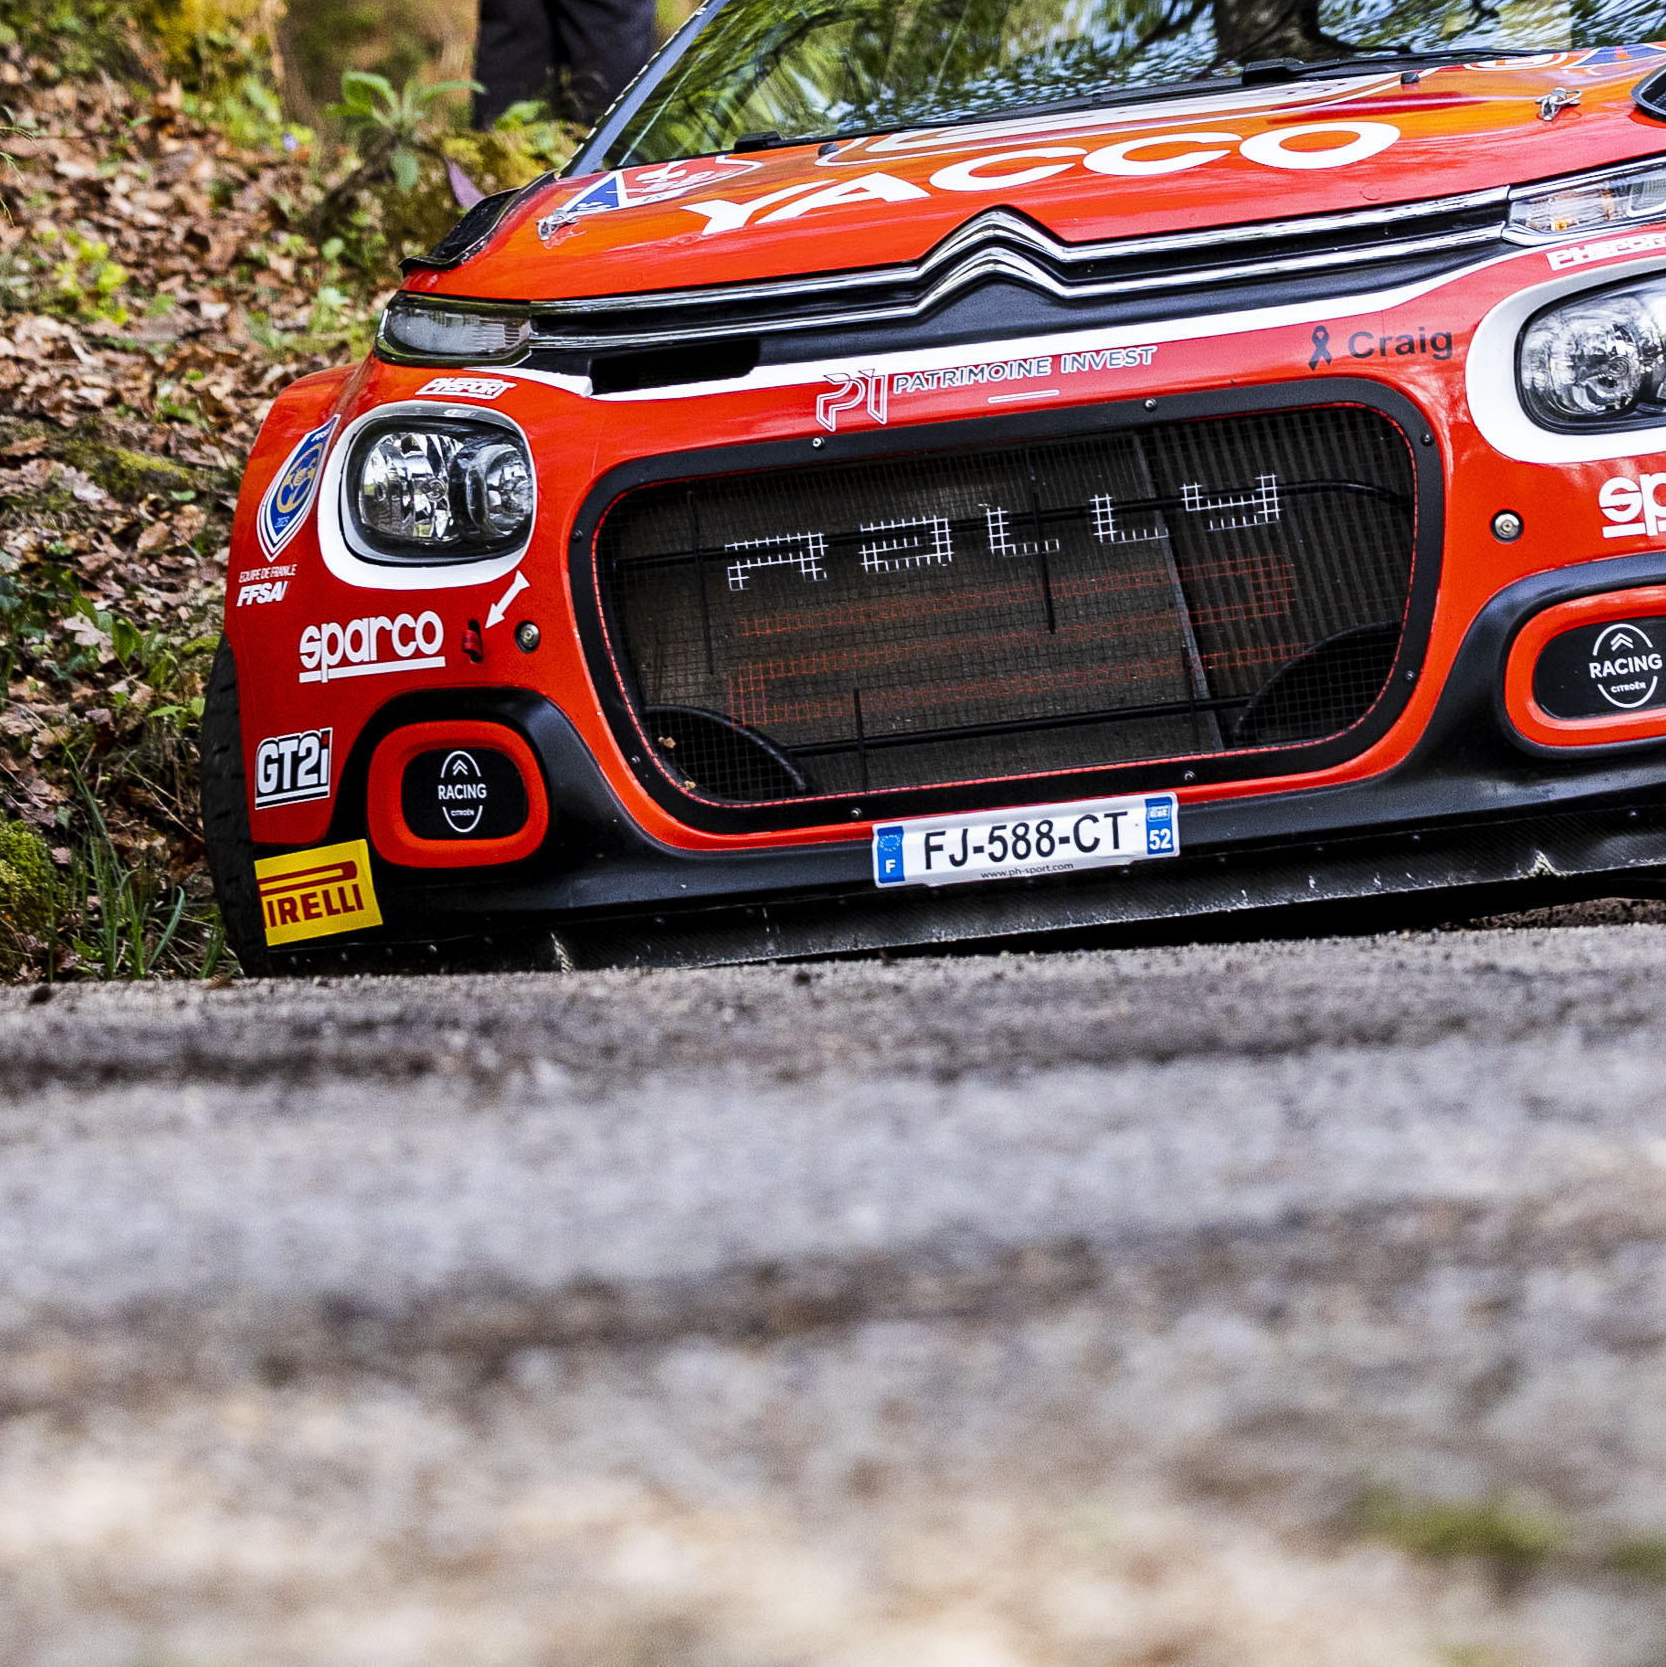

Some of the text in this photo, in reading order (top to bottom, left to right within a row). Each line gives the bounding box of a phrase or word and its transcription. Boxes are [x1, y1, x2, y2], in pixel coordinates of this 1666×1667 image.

[679, 121, 1401, 235] YACCO
[1348, 326, 1453, 358] Craig
[894, 357, 1053, 395] PATRIMOINE
[1061, 346, 1158, 373] INVEST
[299, 610, 444, 682] sparco
[1588, 652, 1663, 679] RACING
[257, 729, 331, 795] GT2i
[438, 783, 488, 800] RACING
[885, 859, 896, 874] F
[924, 810, 1129, 870] FJ-588-CT
[1149, 827, 1173, 851] 52
[980, 861, 1074, 879] www.ph-sport.com
